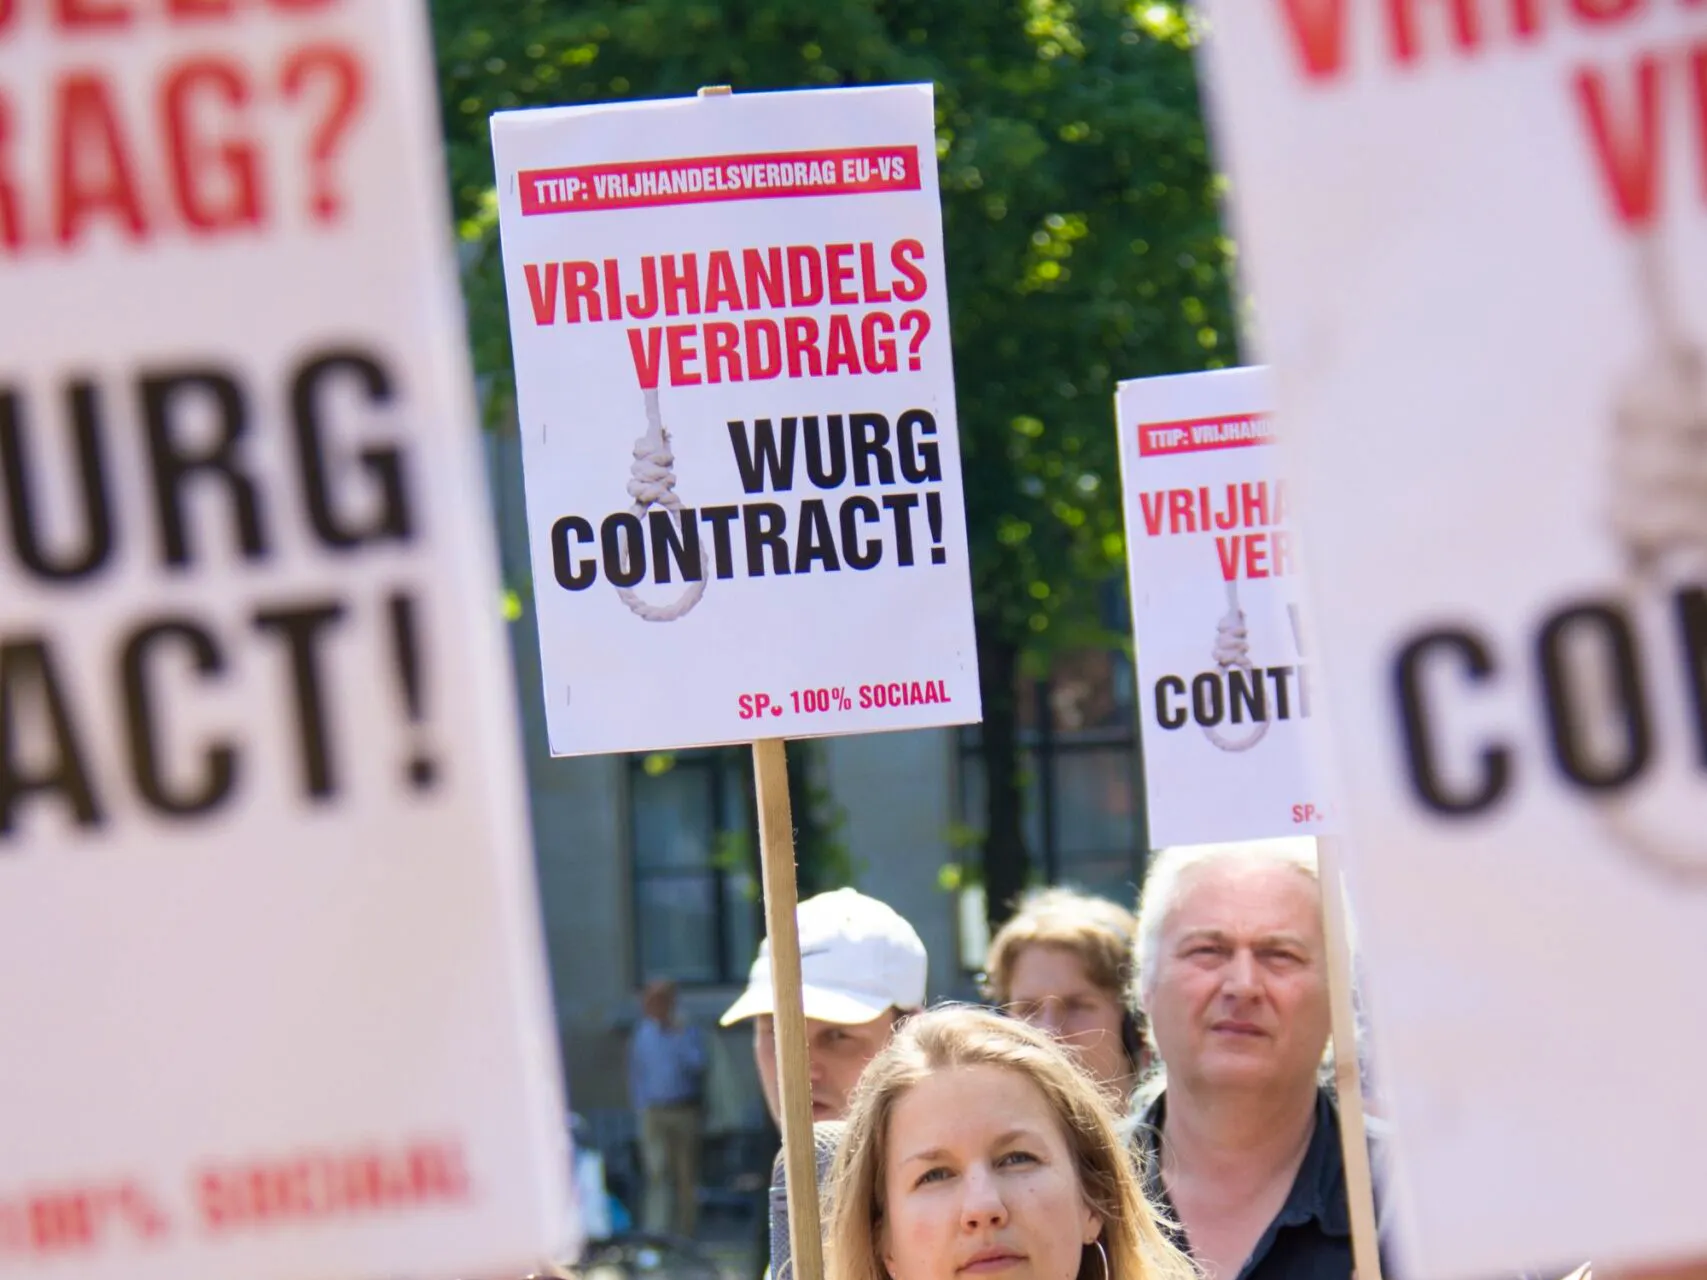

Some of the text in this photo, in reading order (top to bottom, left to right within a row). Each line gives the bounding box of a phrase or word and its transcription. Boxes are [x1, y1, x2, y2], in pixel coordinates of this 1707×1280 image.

[0, 44, 366, 252] AG?
[534, 156, 906, 204] TTIP: VRIJHANDELSVERDRAG EU-VS
[524, 238, 928, 326] VRIJHANDELS
[627, 309, 932, 389] VERDRAG?
[727, 408, 942, 494] WURG
[1148, 420, 1273, 448] TTIP: VRIJHAN
[551, 491, 946, 591] CONTRACT!
[790, 686, 851, 713] 100%
[859, 680, 951, 708] SOCIAAL
